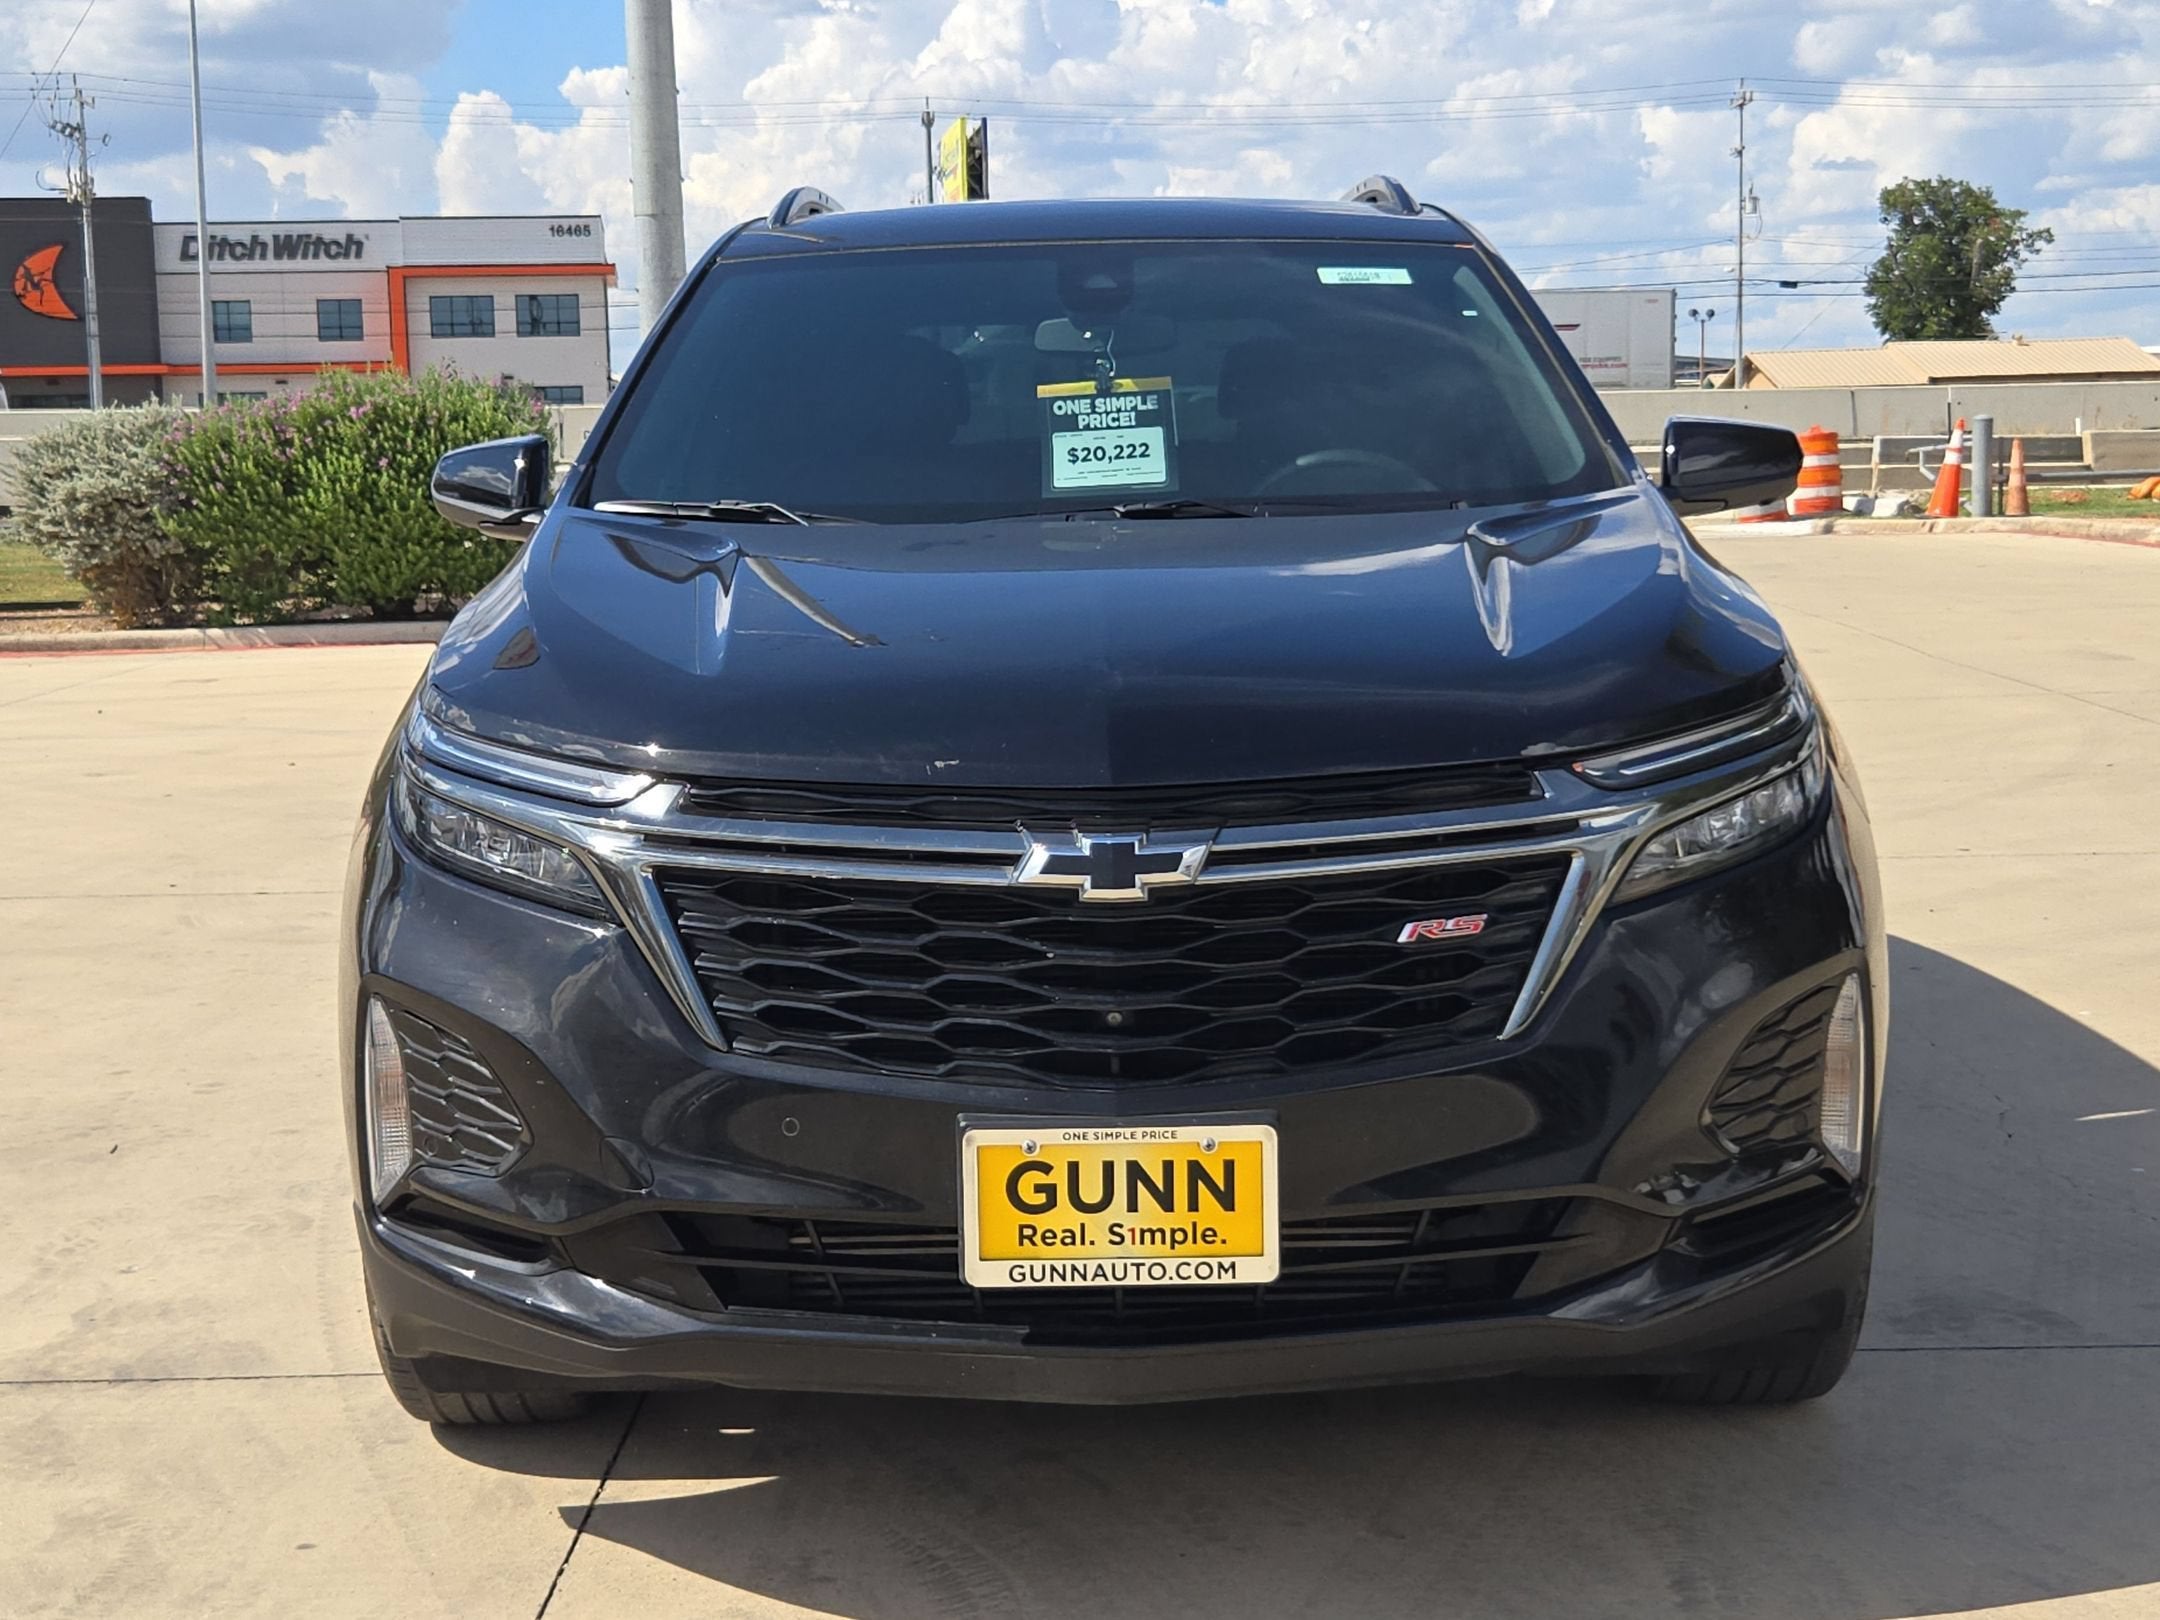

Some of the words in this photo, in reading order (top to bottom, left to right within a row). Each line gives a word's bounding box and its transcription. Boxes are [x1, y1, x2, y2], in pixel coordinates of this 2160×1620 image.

[180, 234, 269, 262] Ditch
[272, 233, 365, 261] Witch
[1053, 399, 1092, 415] ONE
[1095, 395, 1159, 413] SIMPLE
[1078, 411, 1137, 429] PRICE!
[1067, 442, 1151, 465] $20,222
[1397, 913, 1488, 943] RS
[1062, 1132, 1089, 1141] ONE
[1093, 1131, 1138, 1140] SIMPLE
[1142, 1130, 1179, 1140] PRICE
[1005, 1159, 1236, 1216] GUNN
[1018, 1223, 1096, 1247] Real.
[1008, 1261, 1237, 1283] GUNNAUTO.COM
